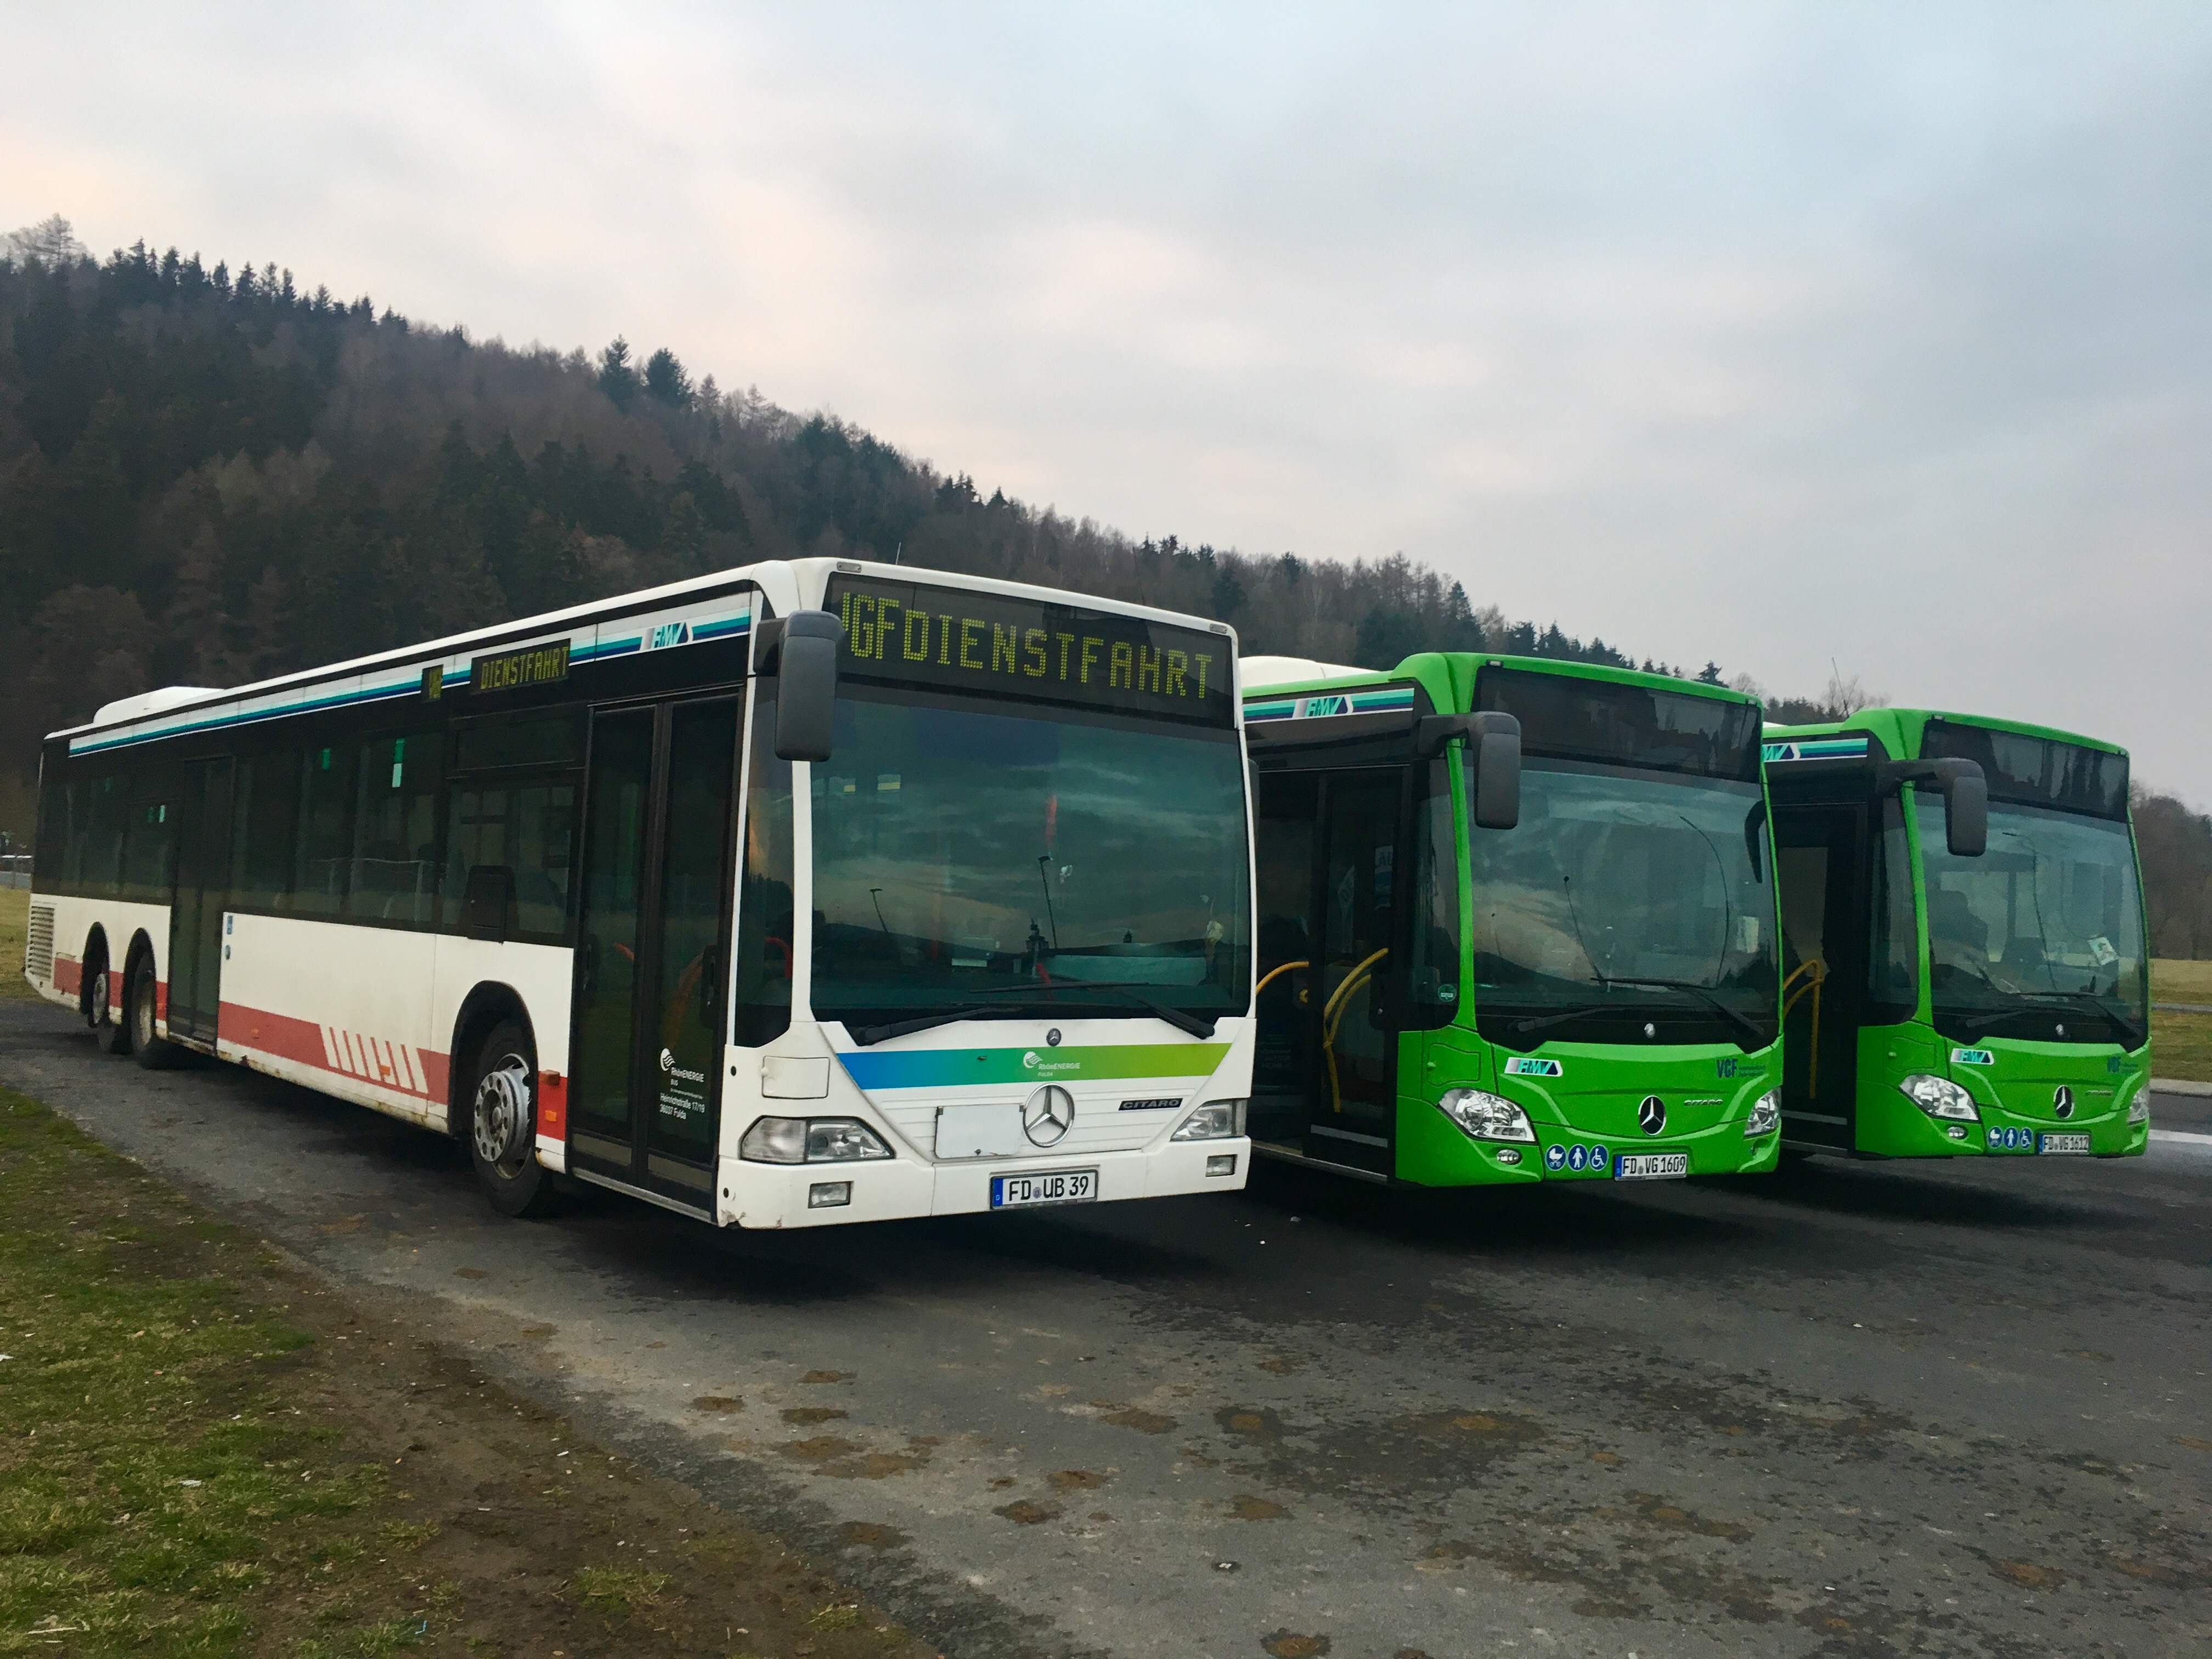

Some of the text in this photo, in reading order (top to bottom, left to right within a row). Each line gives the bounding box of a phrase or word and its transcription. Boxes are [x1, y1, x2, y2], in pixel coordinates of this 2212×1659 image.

[903, 609, 1212, 699] DIENSTFAHRT
[481, 646, 569, 690] DIENSTFAHRT
[1716, 1058, 1738, 1079] VGF
[1122, 1099, 1179, 1108] CITARO
[1623, 1156, 1686, 1174] FD VG 1609
[1009, 1180, 1031, 1201] FD
[1043, 1178, 1064, 1198] UB
[1069, 1176, 1088, 1196] 39
